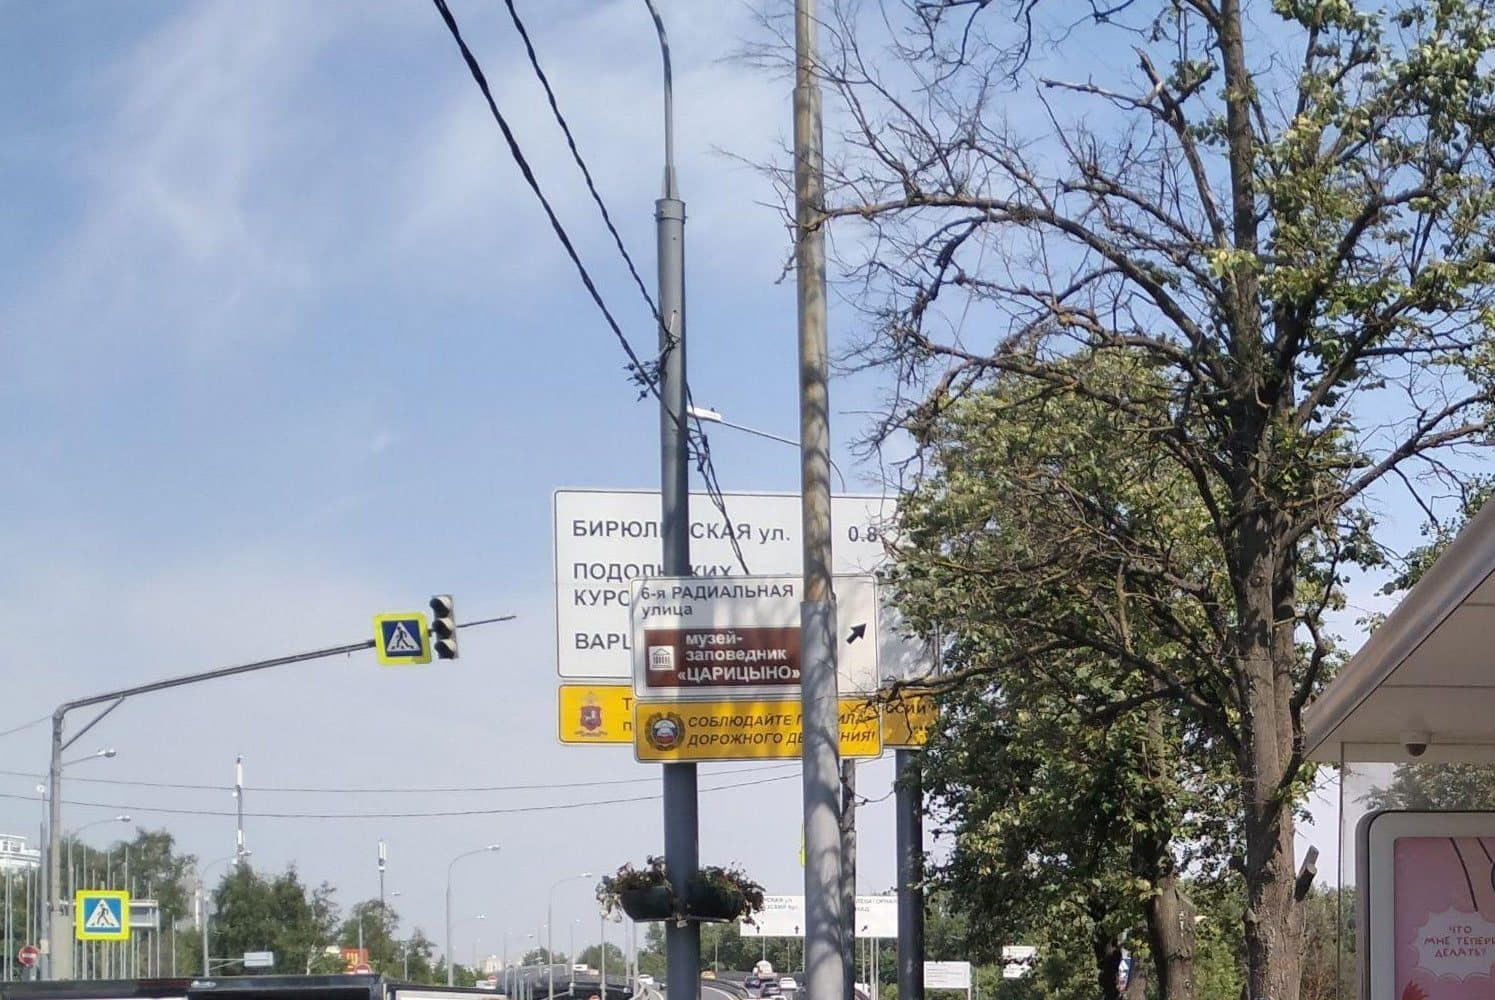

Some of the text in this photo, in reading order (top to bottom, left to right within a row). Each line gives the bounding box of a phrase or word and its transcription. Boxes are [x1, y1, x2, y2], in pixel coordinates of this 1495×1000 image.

[573, 520, 790, 544] БИРЮЛСКАЯ ул.
[641, 584, 794, 600] 6-я РАДИАЛЬНАЯ
[642, 605, 693, 619] улица
[686, 631, 743, 648] музей-
[686, 649, 787, 662] заповедник
[677, 666, 801, 683] «ЦАРИЦЫНО»
[688, 712, 796, 728] СОБЛЮДАЙТЕ
[686, 732, 783, 747] ДОРОЖНОГО
[1448, 924, 1473, 935] ЧТО
[1423, 937, 1451, 946] МНЕ
